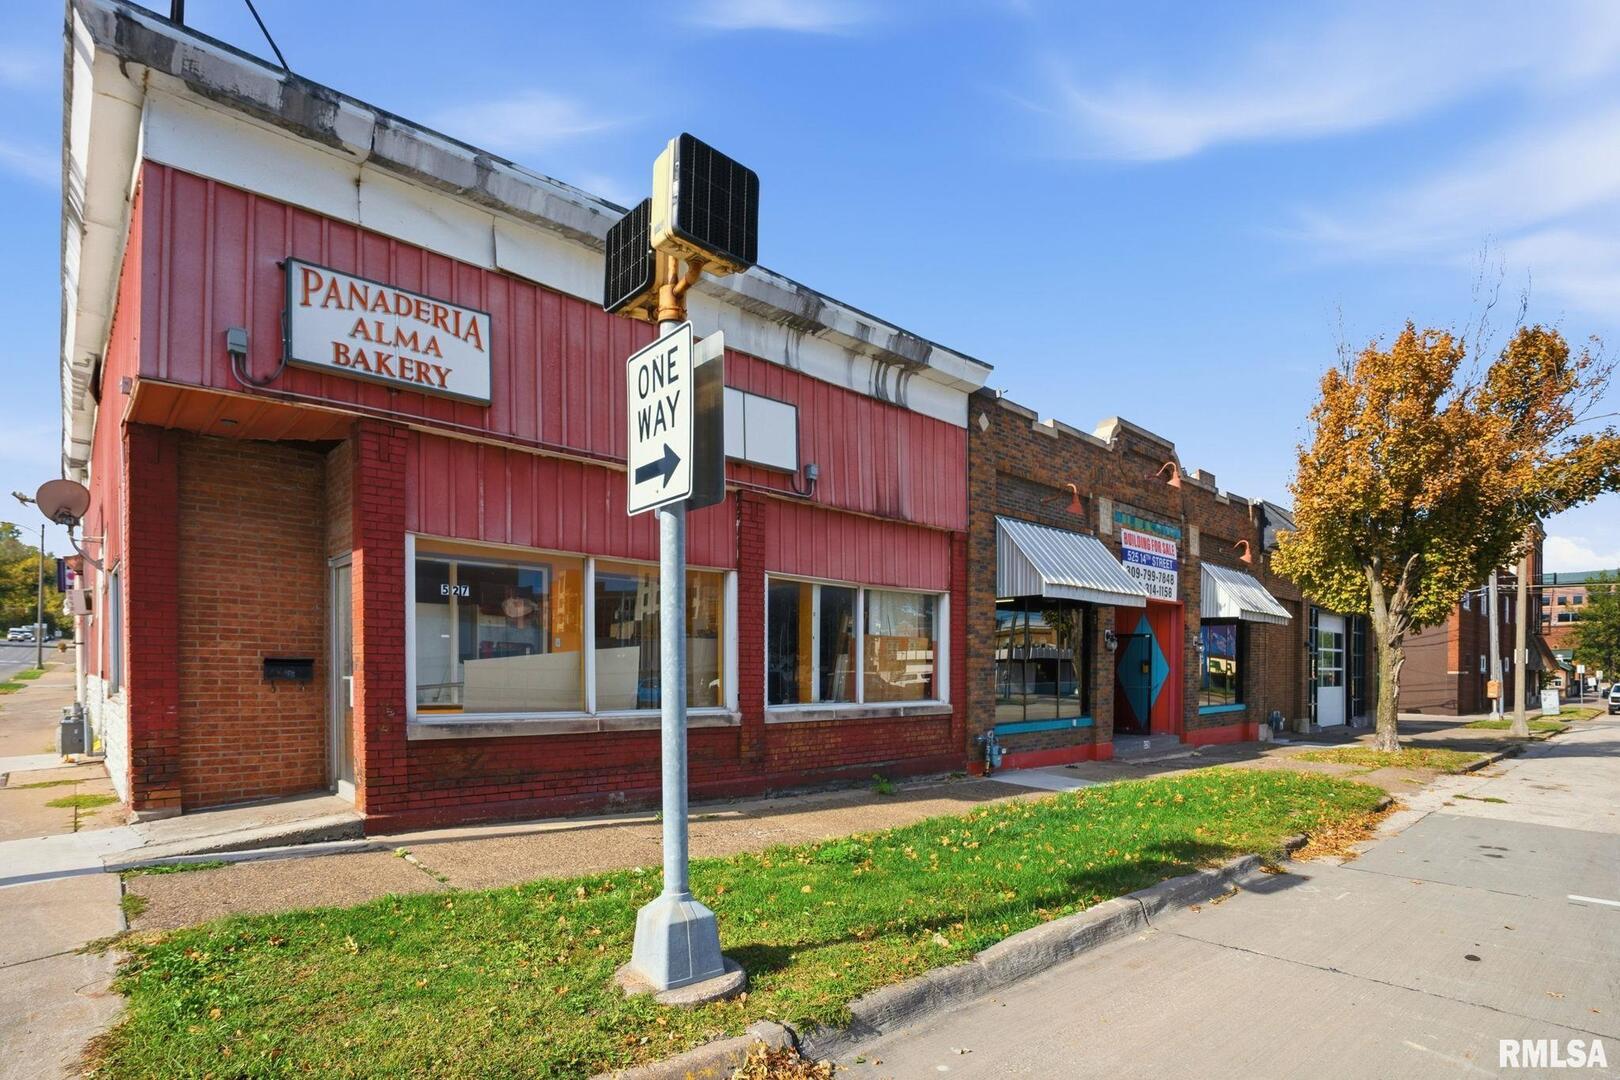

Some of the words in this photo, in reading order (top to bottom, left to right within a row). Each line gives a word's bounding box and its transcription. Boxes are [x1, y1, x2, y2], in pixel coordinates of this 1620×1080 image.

[299, 267, 485, 352] PANADERIA
[350, 317, 443, 359] ALMA
[331, 341, 453, 389] BAKERY
[638, 345, 679, 400] ONE
[638, 389, 680, 443] WAY
[1123, 532, 1151, 551] BUILDING
[1151, 539, 1162, 553] FOR
[1162, 542, 1175, 557] SALE
[1127, 550, 1139, 562] 525
[1151, 556, 1173, 569] STREET
[441, 584, 469, 596] 527
